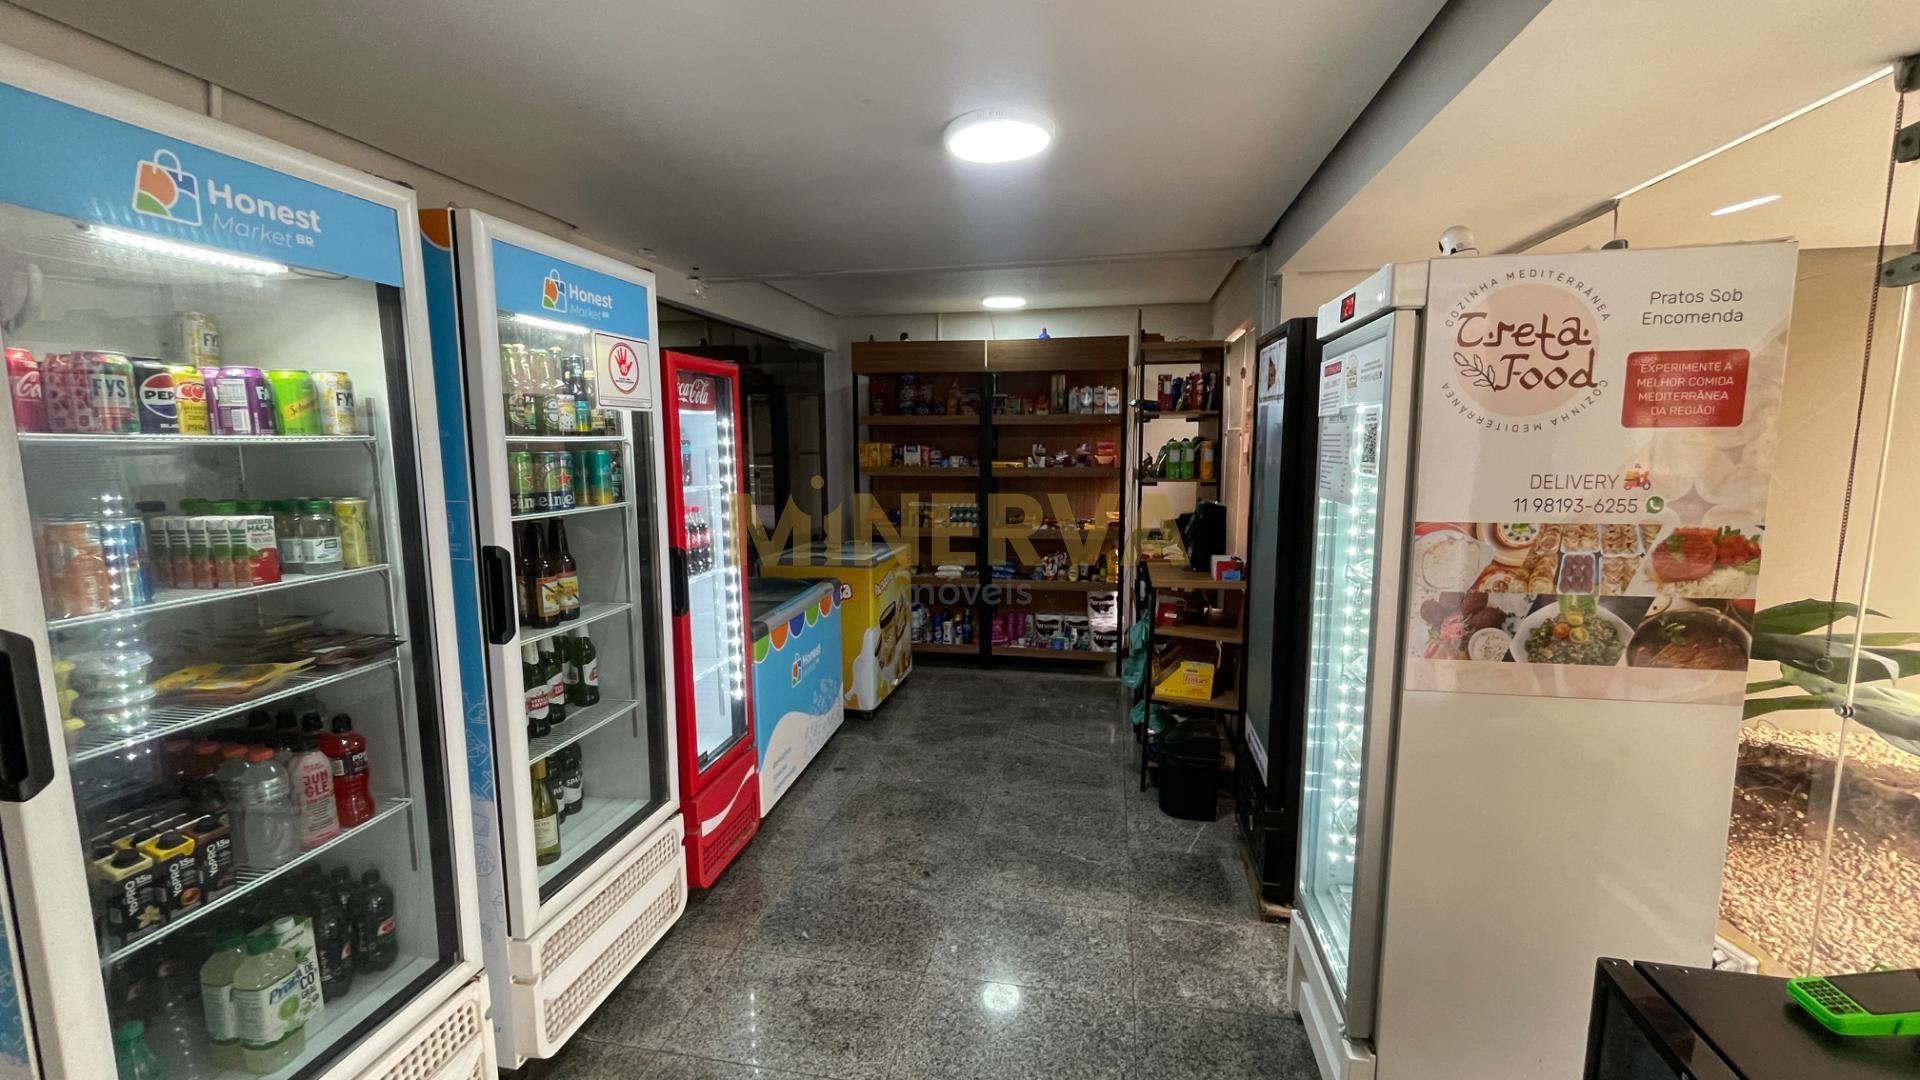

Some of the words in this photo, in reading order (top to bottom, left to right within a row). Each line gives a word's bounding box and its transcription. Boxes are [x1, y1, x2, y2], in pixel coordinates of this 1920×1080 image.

[207, 179, 322, 233] Honest
[213, 213, 293, 248] Market
[569, 283, 613, 309] Honest
[1445, 278, 1499, 327] COZINHA
[1650, 290, 1704, 305] Pratos
[1709, 288, 1743, 303] Sob
[1642, 310, 1743, 326] Encomenda
[1457, 312, 1592, 360] Creta
[1494, 349, 1598, 391] Food
[1640, 362, 1722, 373] EXPERIMENTE
[1724, 361, 1733, 371] A
[92, 379, 127, 399] FYS
[1636, 377, 1685, 388] MELHOR
[1688, 376, 1734, 387] COMIDA
[144, 390, 175, 400] PEP
[1550, 379, 1608, 426] COZINHA
[1650, 406, 1667, 416] DA
[1530, 473, 1619, 490] DELIVERY
[1513, 499, 1528, 513] 11
[1533, 498, 1638, 514] 98193-6255
